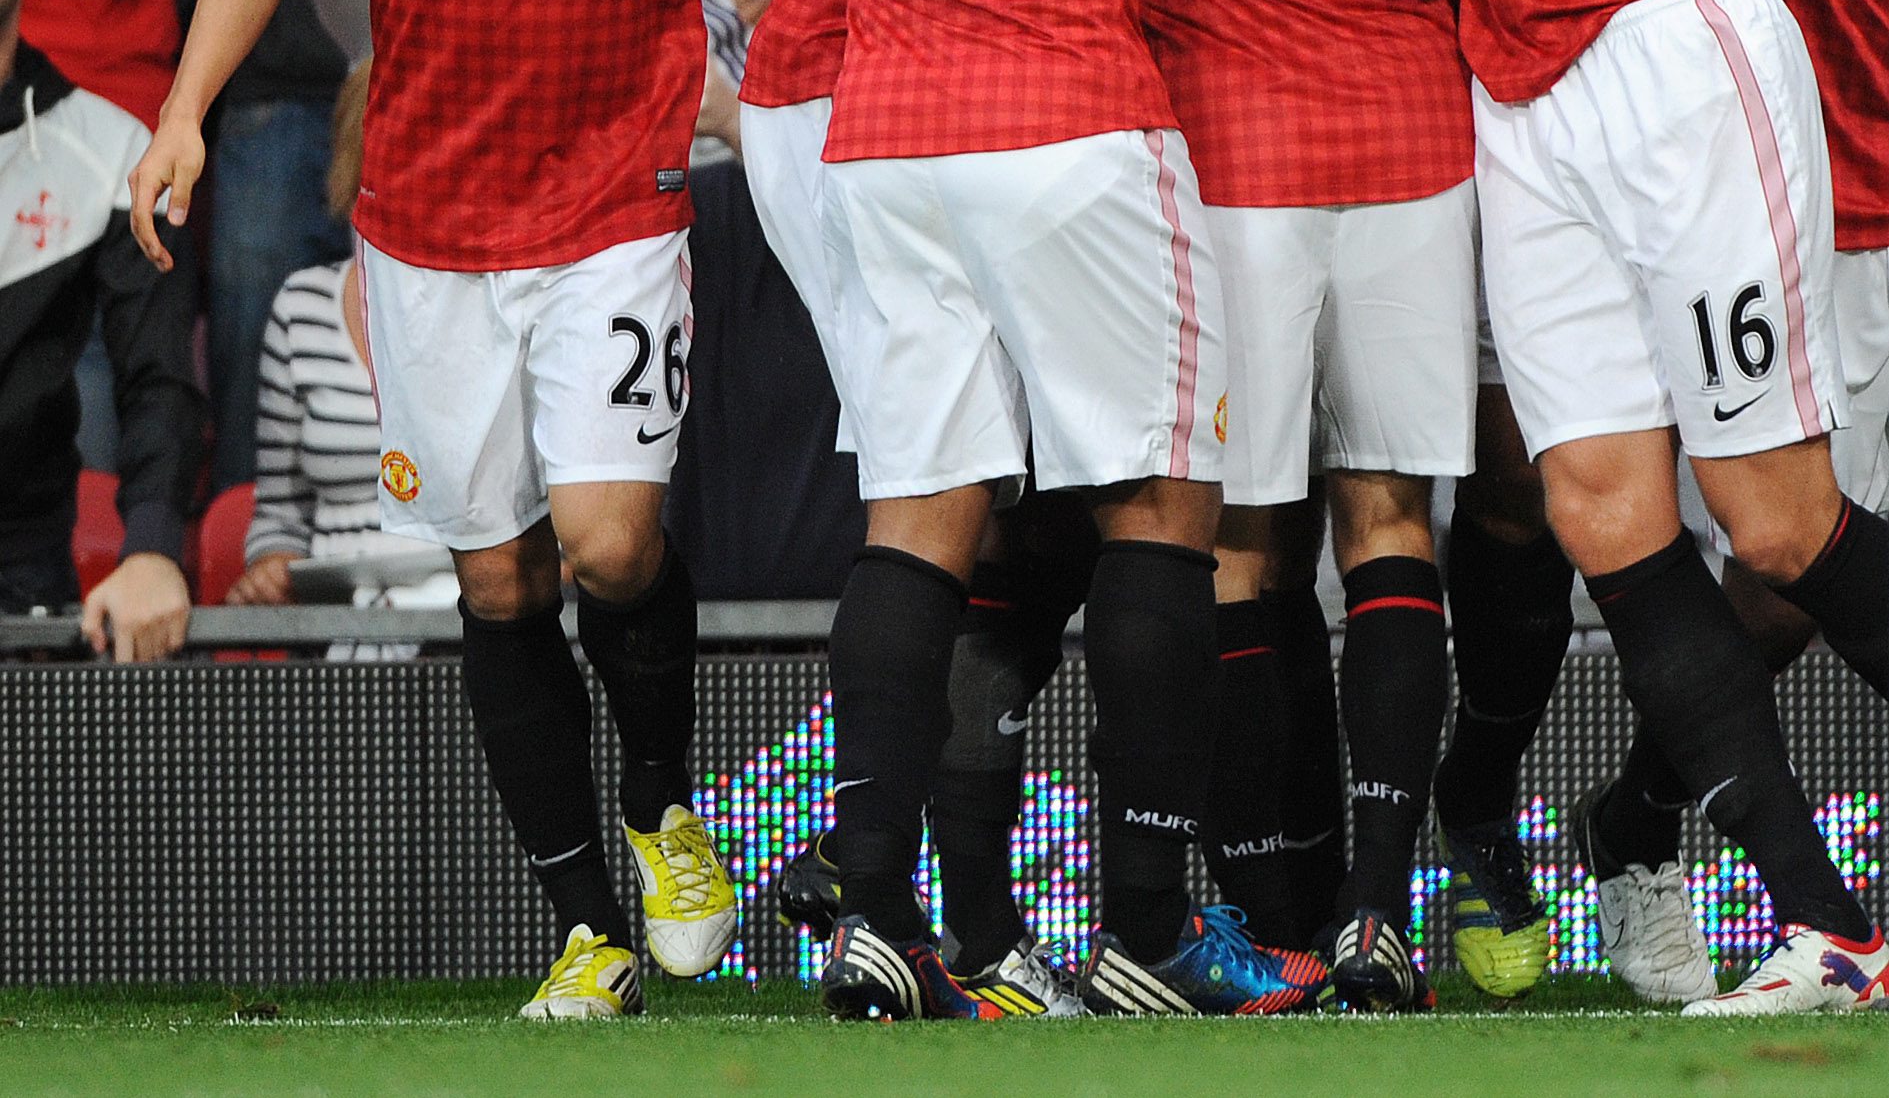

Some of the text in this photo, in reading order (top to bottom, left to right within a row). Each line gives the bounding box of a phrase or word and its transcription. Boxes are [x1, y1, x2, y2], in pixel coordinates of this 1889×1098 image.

[607, 312, 687, 418] 26
[1687, 280, 1779, 392] 16
[1125, 808, 1198, 835] MUFC
